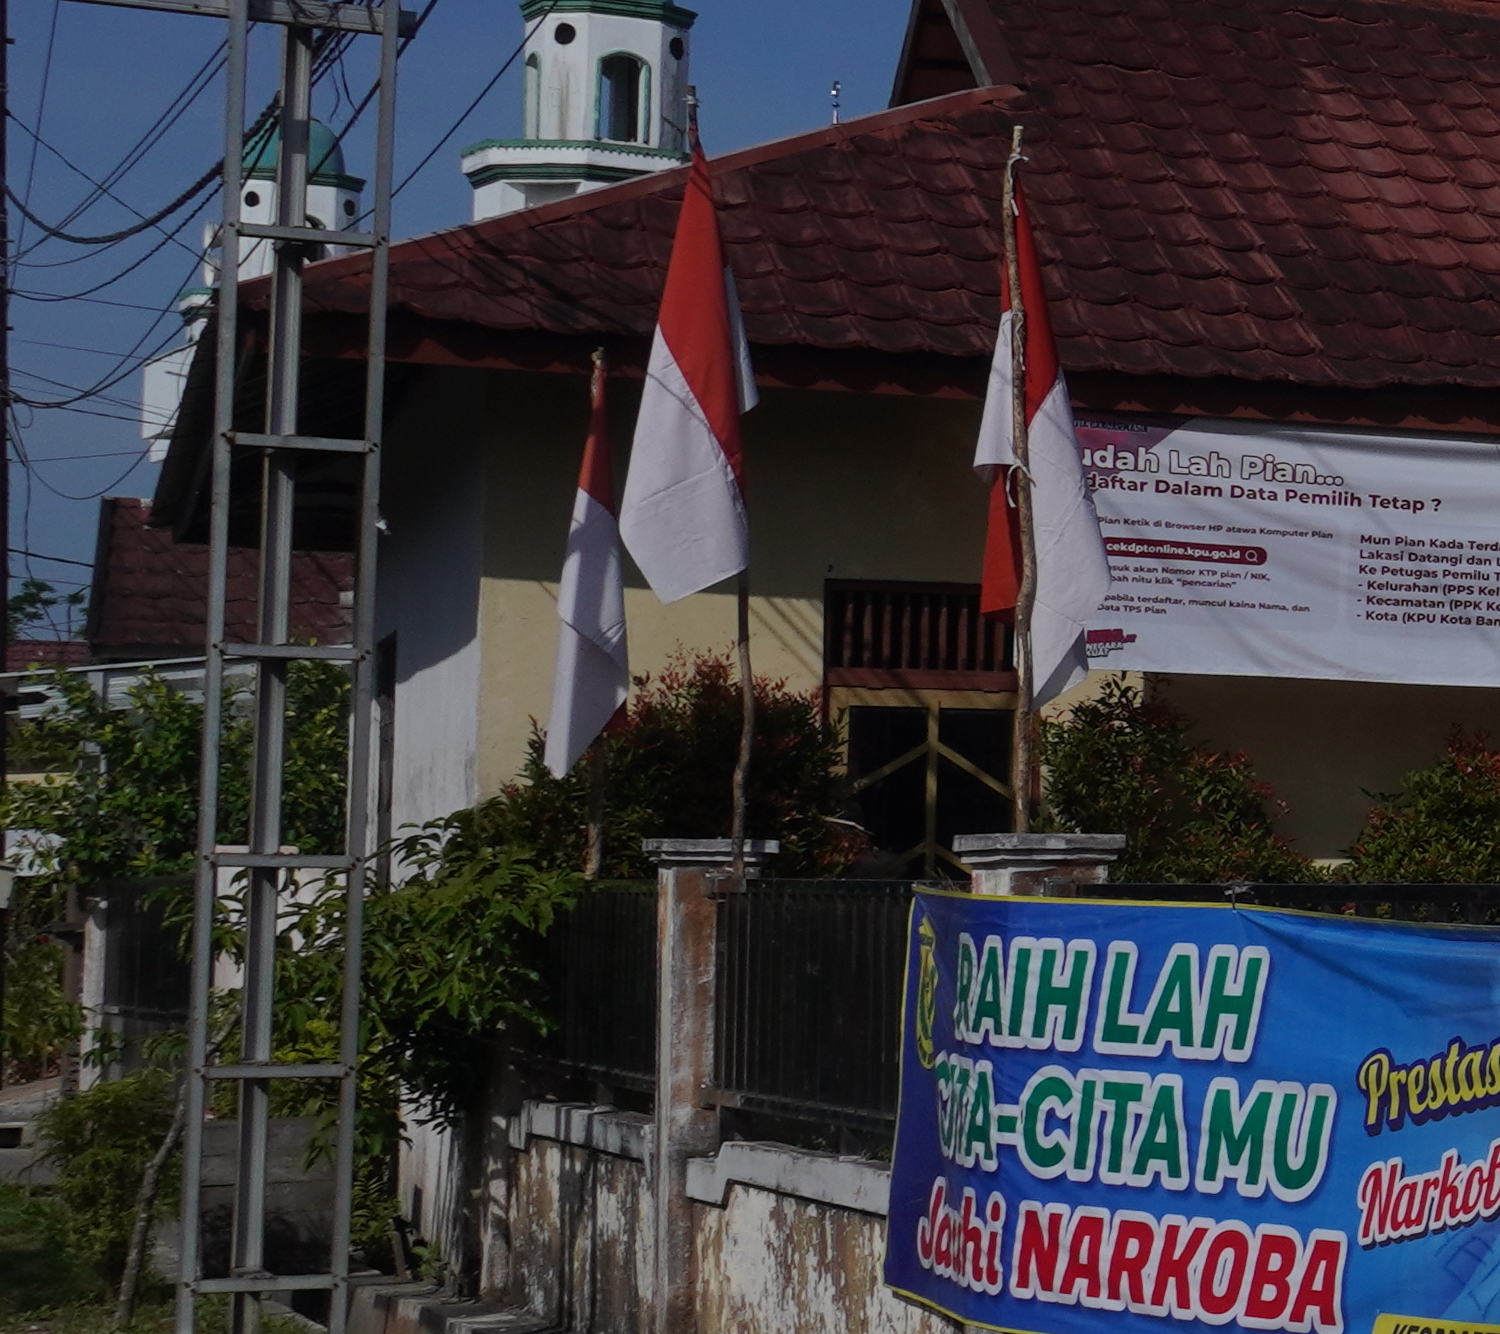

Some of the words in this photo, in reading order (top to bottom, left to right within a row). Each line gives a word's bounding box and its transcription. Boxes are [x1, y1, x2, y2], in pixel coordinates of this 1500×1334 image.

[1169, 450, 1231, 478] Lah
[1241, 454, 1344, 487] Pian...
[1155, 480, 1222, 498] Dalam
[1230, 485, 1278, 502] Data
[1285, 489, 1362, 508] Pemilih
[1368, 494, 1425, 514] Tetap
[1431, 498, 1442, 512] ?
[1124, 518, 1150, 527] Ketik
[1153, 519, 1162, 528] di
[1165, 521, 1206, 531] Browser
[1209, 524, 1223, 532] HP
[1226, 526, 1257, 535] atawa
[1260, 527, 1310, 538] Komputer
[1311, 530, 1334, 539] Pian
[1105, 542, 1241, 559] cekdptonline.kpu.go.id
[1360, 534, 1391, 546] Mun
[1395, 536, 1425, 548] Pian
[1430, 538, 1464, 550] Kada
[1359, 549, 1405, 562] Lakasi
[1408, 552, 1463, 566] Datangi
[1466, 554, 1493, 566] dan
[1131, 575, 1152, 584] nitu
[1155, 576, 1174, 585] klik
[1133, 564, 1158, 573] akan
[1161, 566, 1195, 576] Nomor
[1220, 570, 1242, 579] pian
[1358, 565, 1378, 576] Ke
[1381, 566, 1439, 581] Petugas
[1442, 569, 1490, 582] Pemilu
[1367, 580, 1439, 594] Kelurahan
[1442, 583, 1474, 596] (PPS
[1123, 605, 1142, 613] TPS
[1144, 606, 1167, 614] Pian
[1137, 596, 1186, 606] terdaftar,
[1188, 599, 1227, 607] muncul
[1258, 603, 1290, 612] Nama,
[1291, 604, 1311, 612] dan
[1366, 595, 1446, 610] Kecamatan
[1449, 598, 1483, 612] (PPK
[1365, 610, 1398, 622] Kota
[1402, 612, 1436, 625] (KPU
[1440, 613, 1472, 626] Kota
[955, 935, 1094, 1049] RAIH
[1099, 946, 1269, 1060] LAH
[1197, 1080, 1334, 1198] MU
[1011, 1203, 1344, 1334] NARKOBA
